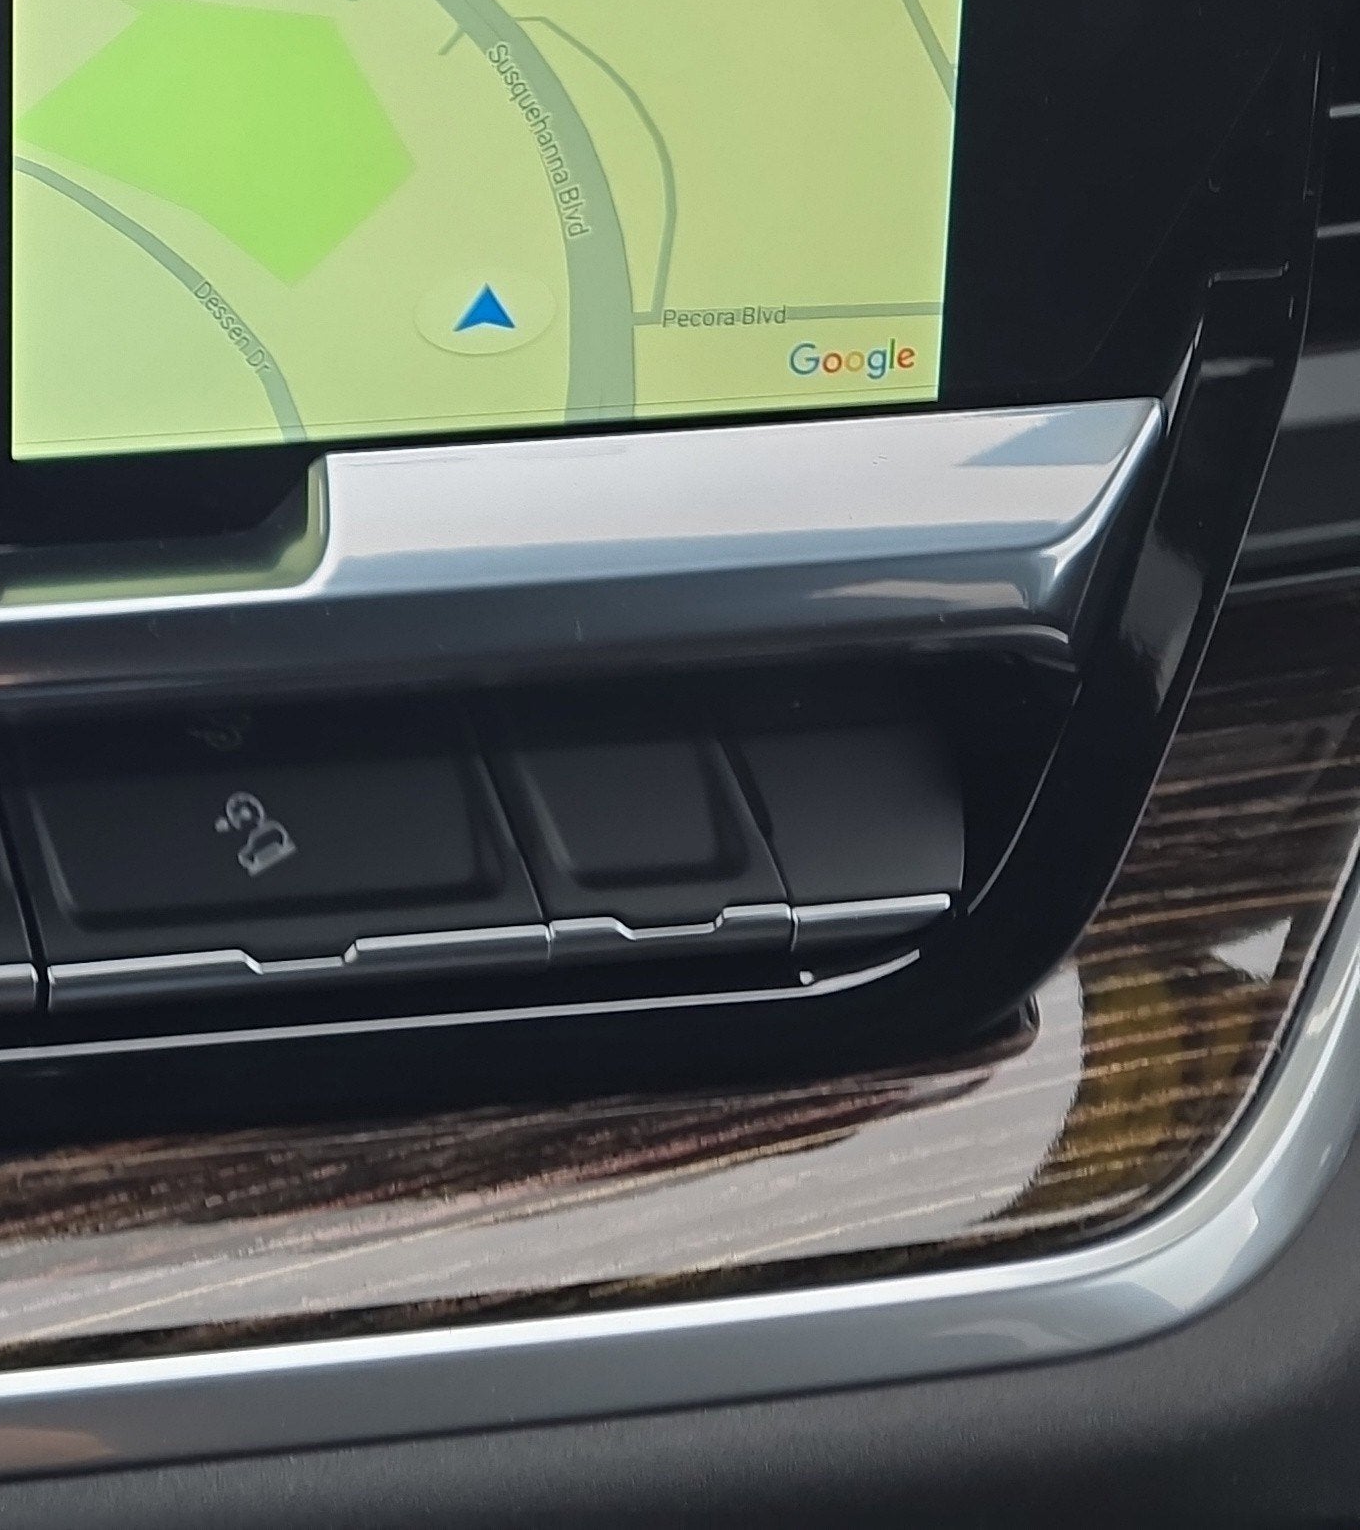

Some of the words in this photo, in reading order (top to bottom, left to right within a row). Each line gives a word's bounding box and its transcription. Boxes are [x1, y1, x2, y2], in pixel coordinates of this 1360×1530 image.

[488, 44, 569, 185] Susquehanna
[559, 186, 589, 237] Blvd
[194, 281, 249, 352] Dessen
[246, 350, 269, 373] Dr
[663, 309, 735, 327] Pecora
[742, 306, 786, 325] Blvd
[790, 338, 916, 380] Google
